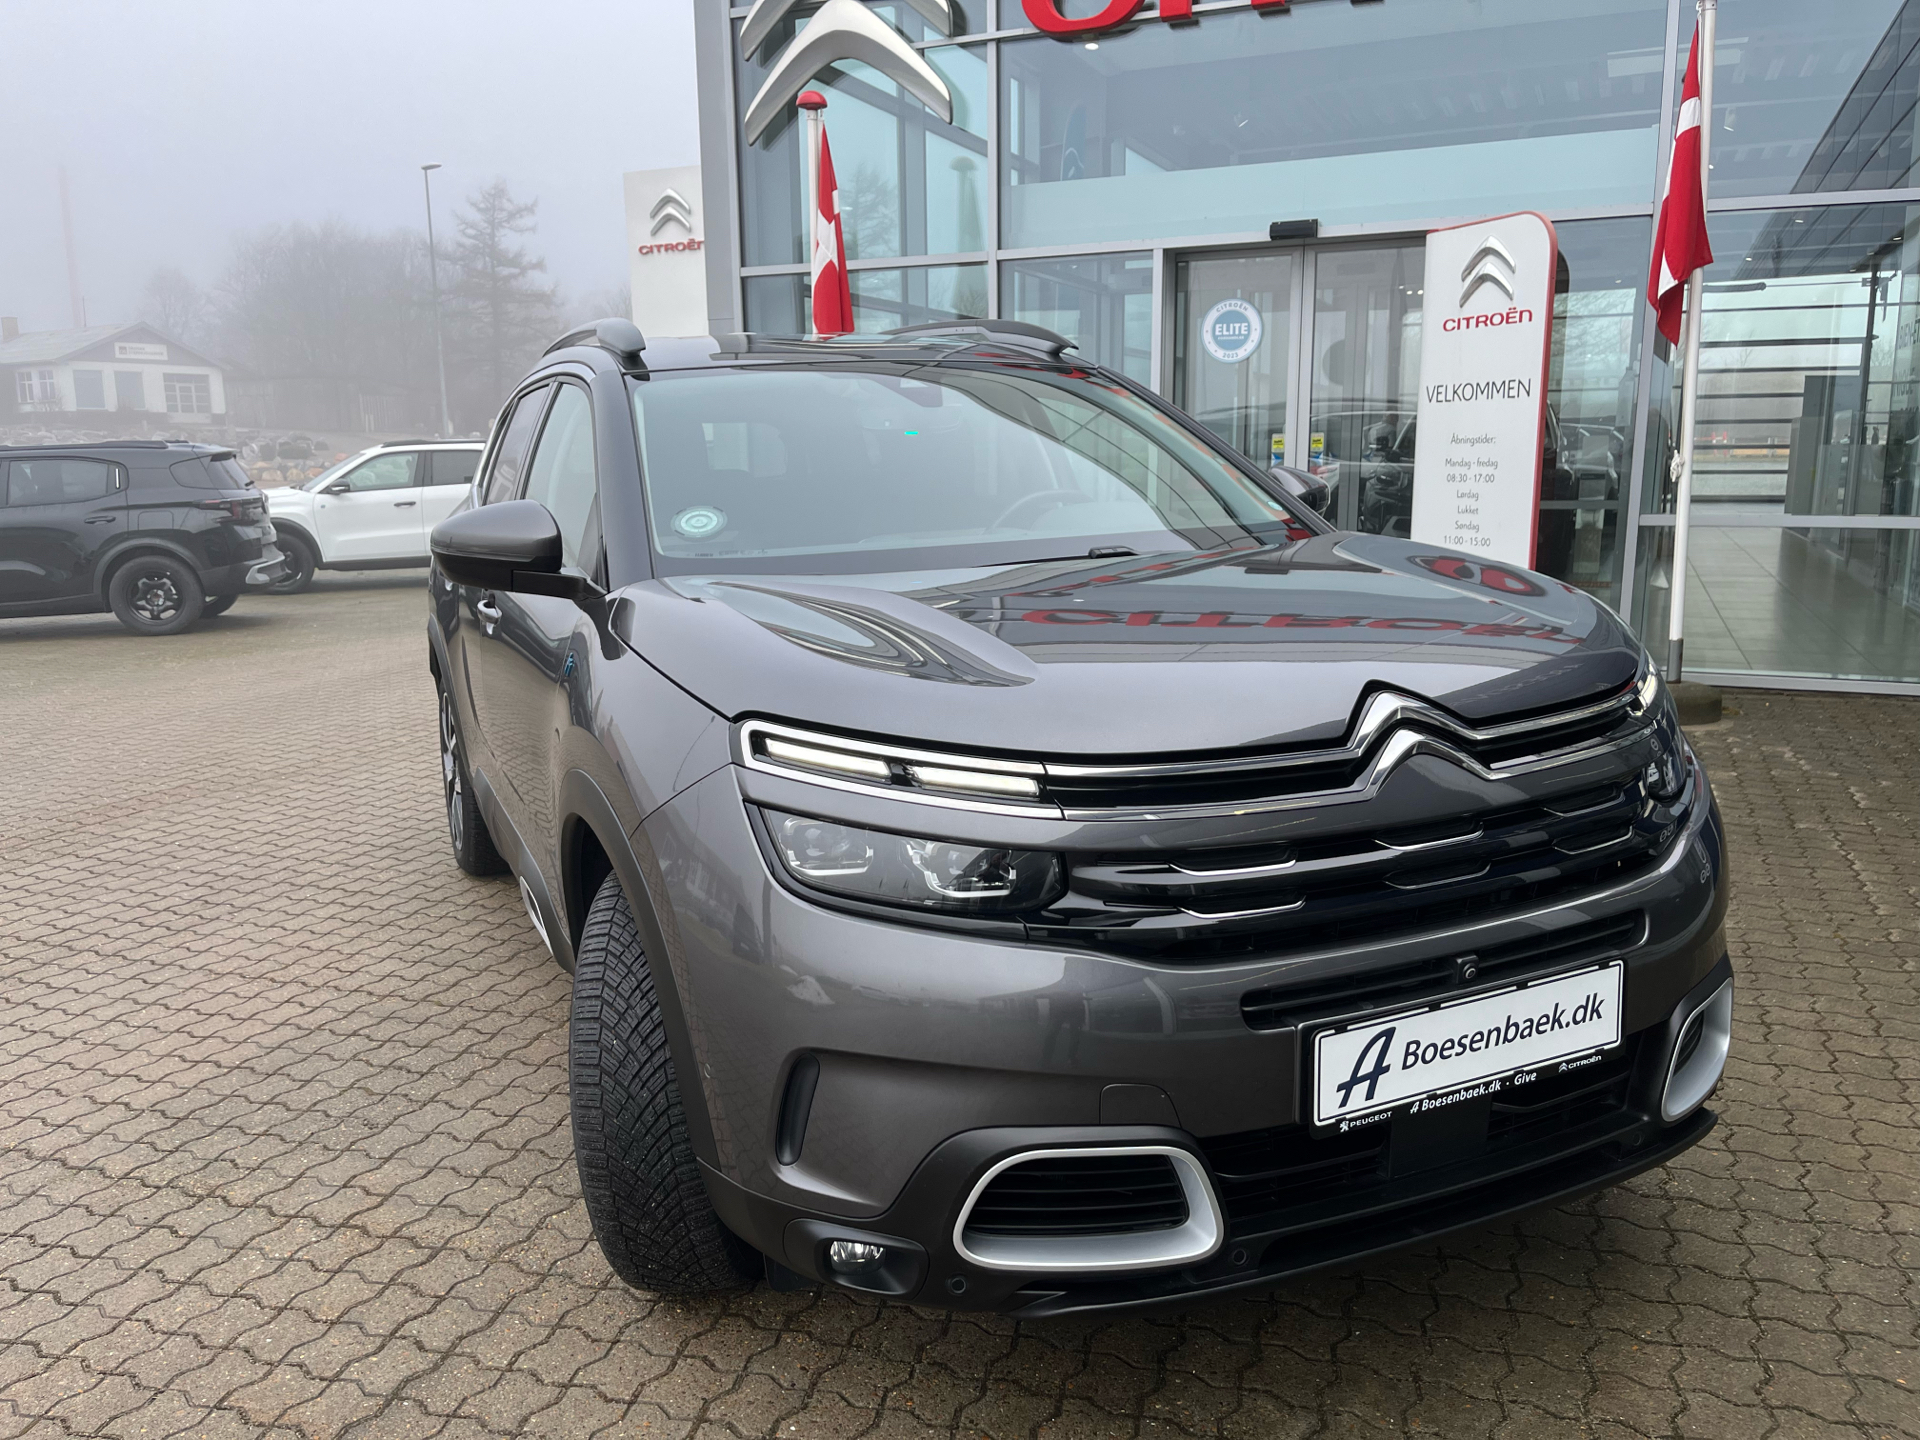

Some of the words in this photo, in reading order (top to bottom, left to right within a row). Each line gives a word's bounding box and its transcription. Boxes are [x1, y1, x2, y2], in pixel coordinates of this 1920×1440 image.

[1215, 322, 1249, 335] ELITE
[1426, 378, 1531, 403] VELKOMMEN
[1445, 457, 1471, 470] Mandag
[1476, 456, 1498, 470] fredag
[1446, 473, 1468, 483] 08:30
[1473, 473, 1495, 483] 17:00
[1456, 489, 1479, 502] Lørdag
[1457, 504, 1479, 515] Lukket
[1455, 520, 1480, 533] Søndag
[1444, 535, 1464, 545] 11:00
[1470, 537, 1491, 547] 15:00
[1401, 992, 1606, 1071] Boesenbaek.dk
[1421, 1080, 1501, 1111] Boesenbaek.dk
[1514, 1071, 1537, 1086] Give
[1350, 1110, 1393, 1128] PEUGEOT
